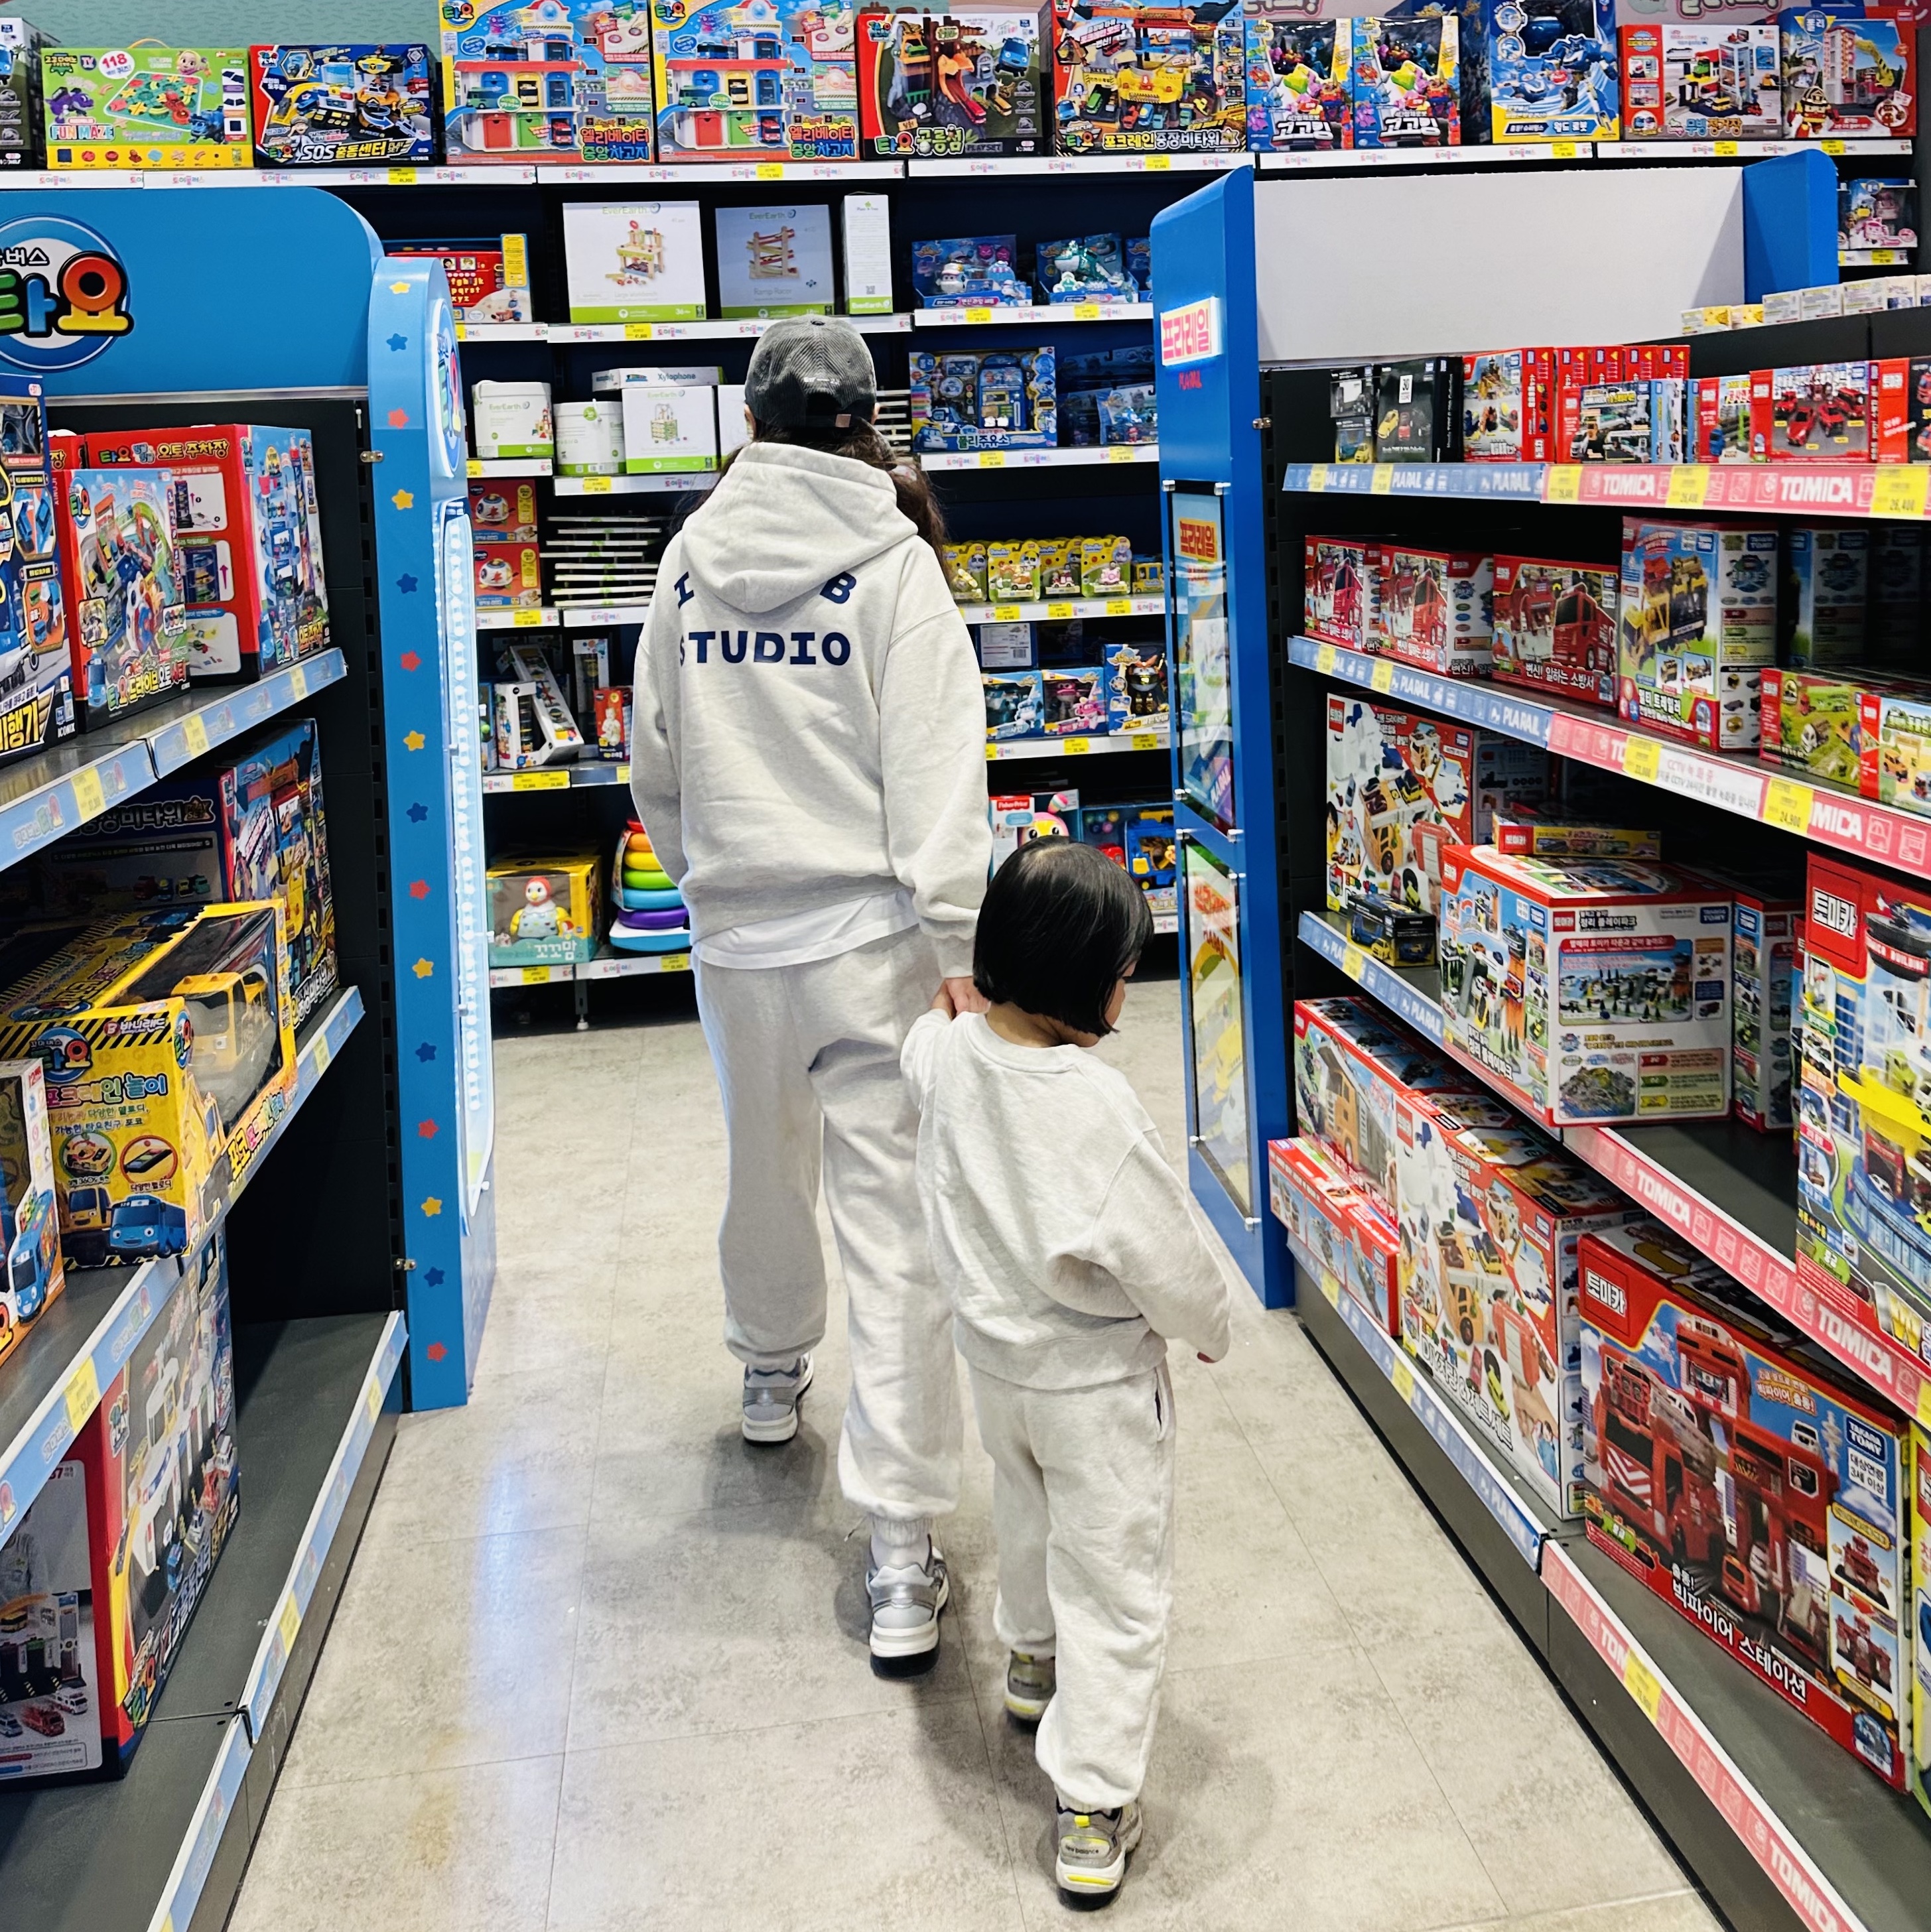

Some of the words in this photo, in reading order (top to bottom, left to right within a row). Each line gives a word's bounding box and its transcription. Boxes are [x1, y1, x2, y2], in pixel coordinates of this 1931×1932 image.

[442, 3, 474, 19] 타요
[655, 3, 685, 19] 타요
[102, 54, 128, 68] 118
[50, 125, 77, 141] FUN
[78, 124, 115, 140] MAZE
[580, 127, 649, 145] 엘리베이터
[789, 125, 854, 142] 엘리베이터
[876, 133, 913, 154] 타요
[917, 127, 964, 155] 공룡섬
[1065, 132, 1094, 147] 타요
[1104, 133, 1154, 148] 포크레인
[1155, 131, 1221, 148] 중장비타워
[267, 144, 294, 159] 타요
[302, 143, 336, 161] SOS
[335, 141, 386, 159] 출동센터
[582, 145, 649, 161] 중앙차고지
[791, 142, 855, 158] 중앙차고지
[0, 247, 49, 266] 버스
[1163, 308, 1211, 360] 프라레일
[657, 371, 696, 382] Xylophone
[99, 446, 131, 464] 타요
[158, 442, 185, 460] 오토
[185, 438, 230, 459] 주차장
[957, 434, 1010, 449] 폴리주유소
[1603, 472, 1655, 496] TOMICA
[1780, 476, 1853, 504] TOMICA
[1179, 519, 1216, 559] 프라레일
[1525, 663, 1543, 679] 변신!
[1545, 665, 1568, 686] 일하는
[107, 676, 129, 711] 타요
[129, 669, 159, 704] 드라이브
[1502, 704, 1540, 736] PLARAIL
[1812, 801, 1863, 842] MICA
[1813, 888, 1859, 938] 토미카
[534, 940, 578, 961] 꼬꼬맘
[1409, 998, 1442, 1037] PLARAIL
[31, 1040, 93, 1070] 타요
[46, 1078, 124, 1108] 포크레인
[125, 1073, 168, 1099] 놀이
[1636, 1167, 1690, 1228] TOMICA
[1586, 1268, 1627, 1316] 토미카
[1818, 1303, 1893, 1385] TOMICA
[1850, 1431, 1883, 1457] TOMY
[1850, 1452, 1885, 1482] 대상연령
[1850, 1468, 1865, 1482] 3세
[1867, 1478, 1885, 1496] 이상
[1672, 1578, 1735, 1646] 빅파이어
[1738, 1634, 1808, 1705] 스테이션
